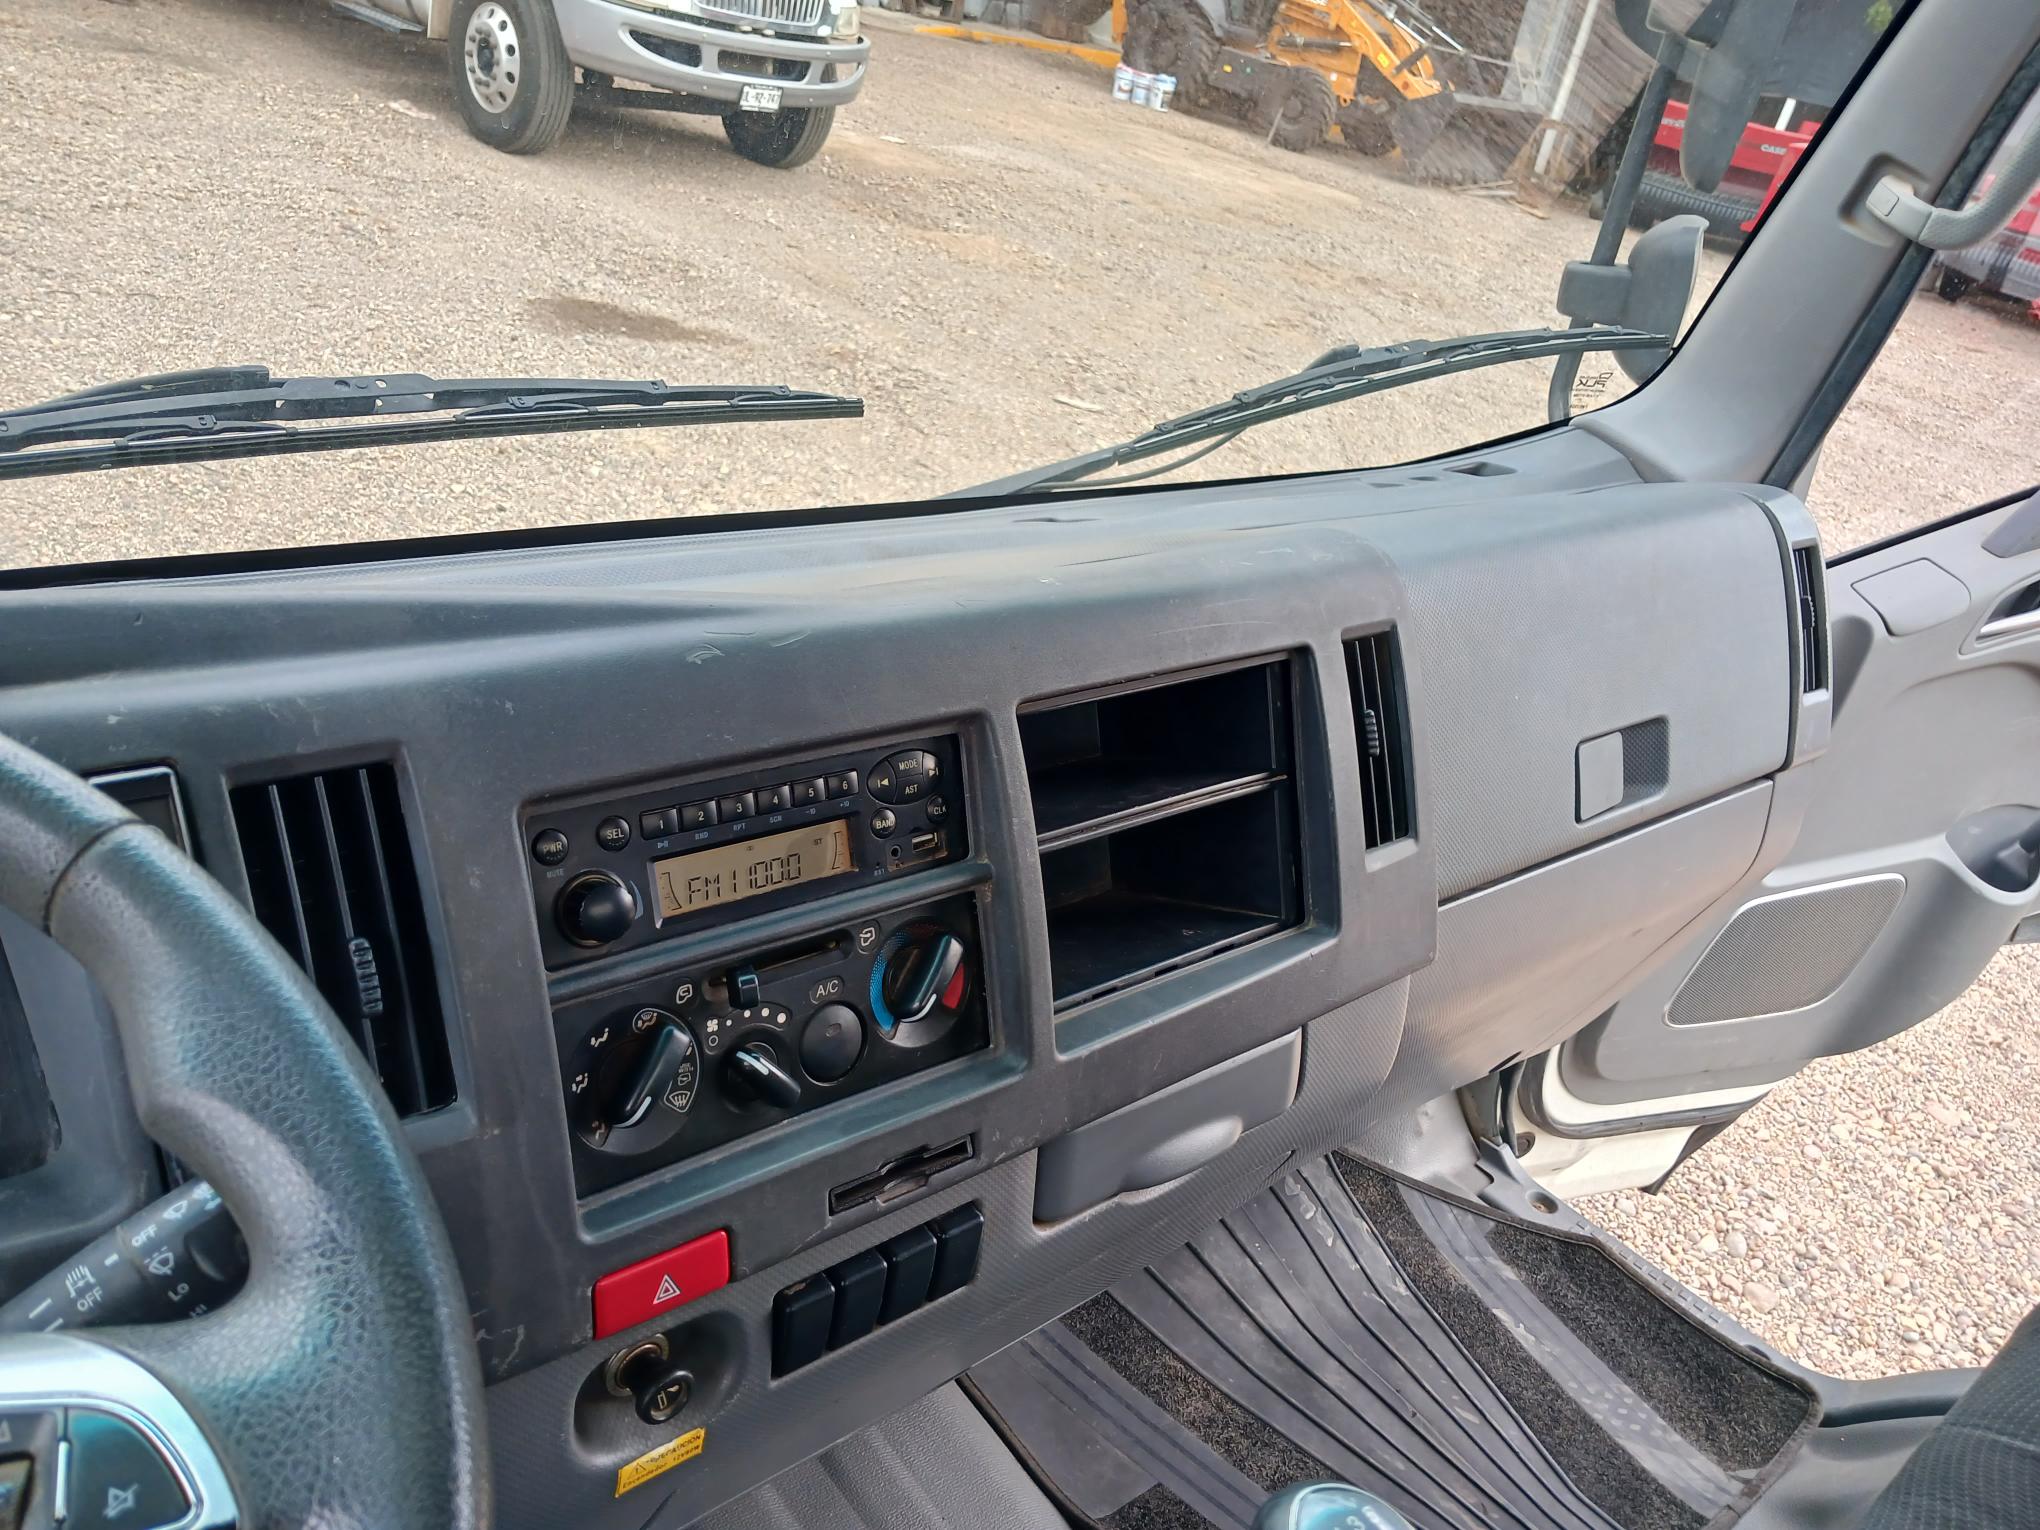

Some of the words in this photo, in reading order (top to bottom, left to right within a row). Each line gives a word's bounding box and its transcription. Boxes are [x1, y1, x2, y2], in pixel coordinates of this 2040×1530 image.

[898, 759, 919, 770] MODE
[842, 780, 848, 790] 6
[905, 784, 918, 795] AST
[808, 787, 815, 797] 5
[773, 795, 779, 805] 4
[736, 803, 743, 813] 3
[698, 811, 705, 821] 2
[659, 819, 664, 830] 1
[876, 819, 896, 830] BAND
[606, 828, 625, 840] SEL
[543, 841, 563, 855] PWR
[816, 980, 839, 998] A/C
[131, 1224, 158, 1247] OFF
[168, 1283, 190, 1302] LO
[77, 1286, 103, 1312] OFF
